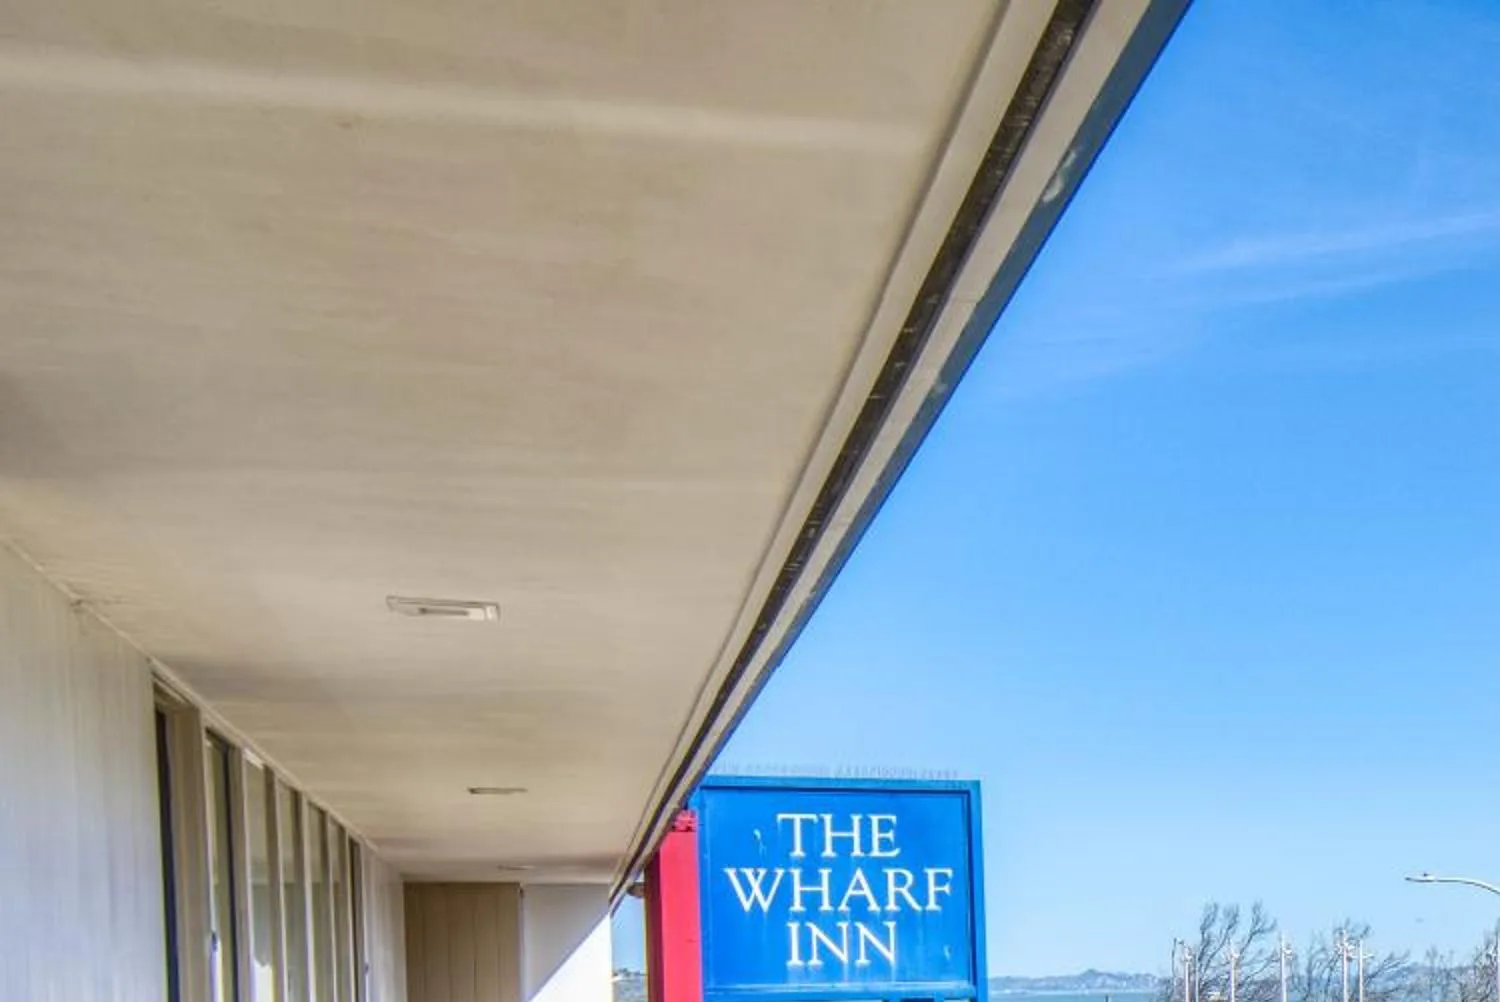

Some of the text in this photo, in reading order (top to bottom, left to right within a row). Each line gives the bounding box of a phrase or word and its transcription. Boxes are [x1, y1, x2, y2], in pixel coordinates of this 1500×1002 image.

[776, 813, 901, 858] THE
[723, 867, 953, 912] WHARF
[786, 921, 897, 966] INN
